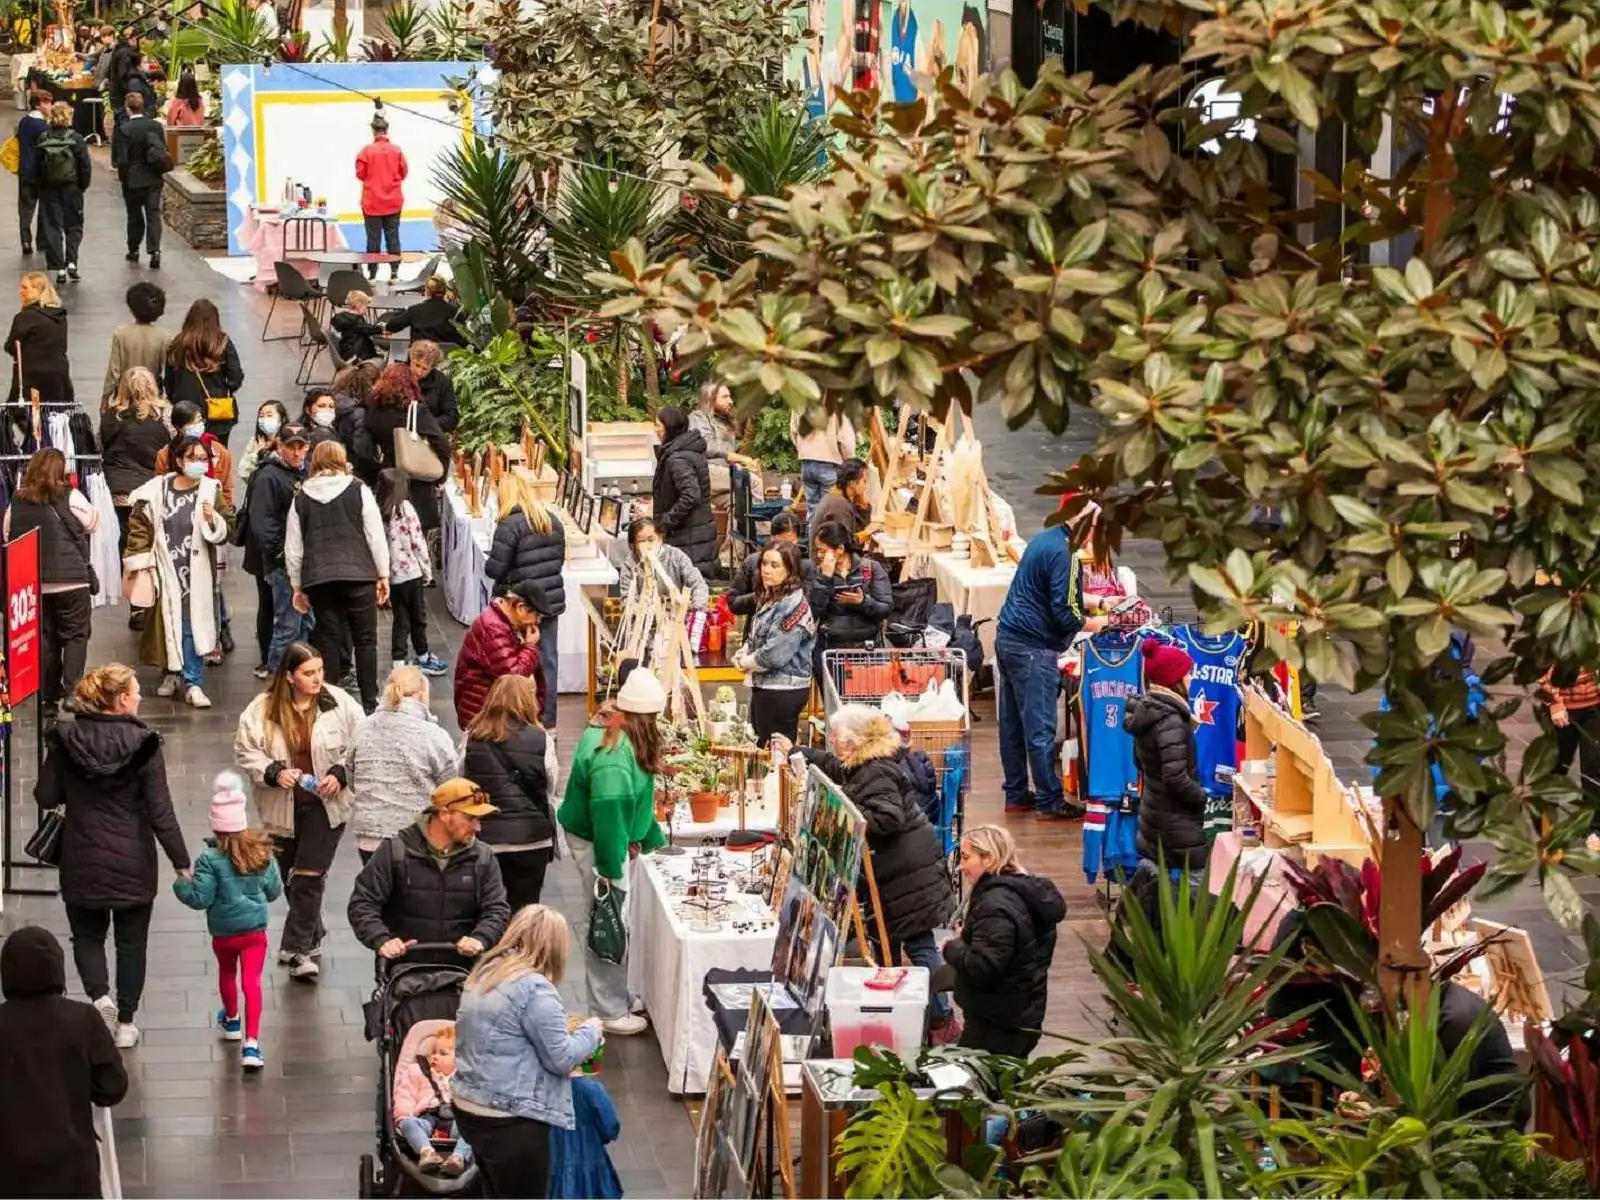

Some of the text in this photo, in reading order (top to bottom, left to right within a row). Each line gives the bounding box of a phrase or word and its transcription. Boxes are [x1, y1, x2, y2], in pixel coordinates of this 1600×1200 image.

[161, 489, 198, 520] Lov
[11, 583, 37, 632] 30%
[1105, 703, 1119, 728] 3
